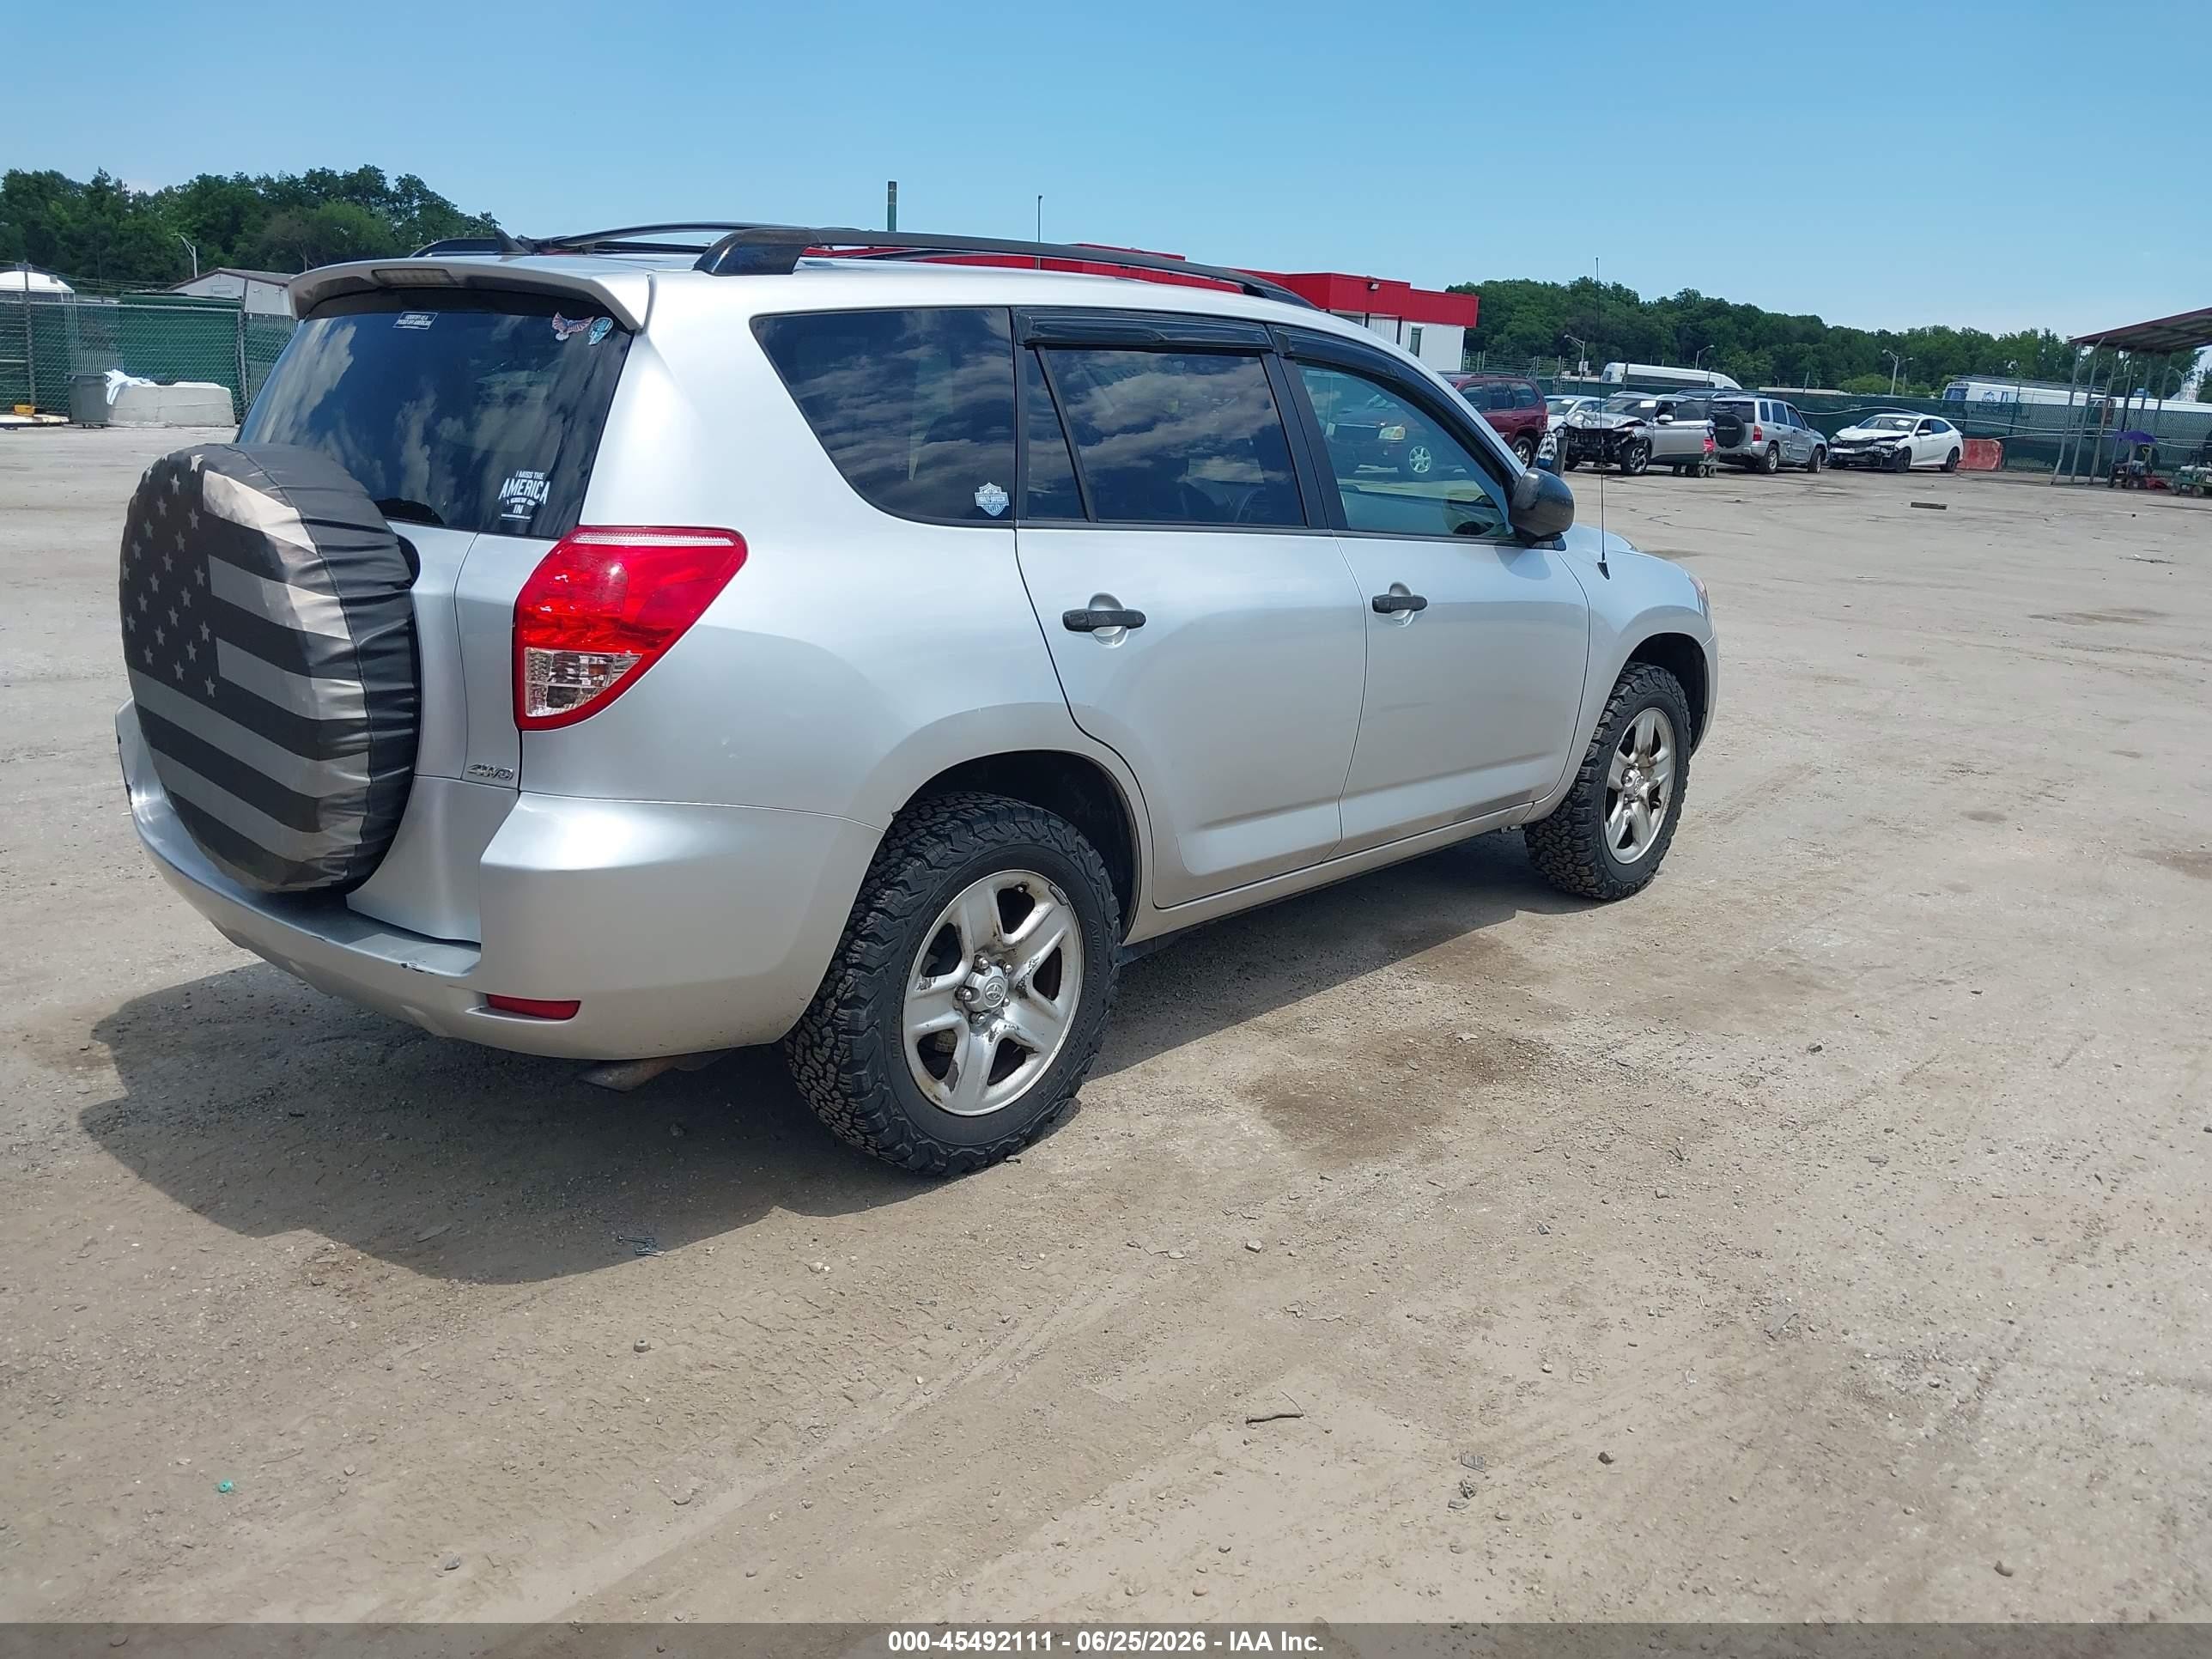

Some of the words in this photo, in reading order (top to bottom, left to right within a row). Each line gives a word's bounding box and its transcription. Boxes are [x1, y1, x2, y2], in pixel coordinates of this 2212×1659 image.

[515, 470, 520, 478] I
[518, 471, 533, 479] MISS
[533, 471, 544, 480] THE
[498, 477, 550, 505] AMERICA
[513, 504, 524, 514] IN
